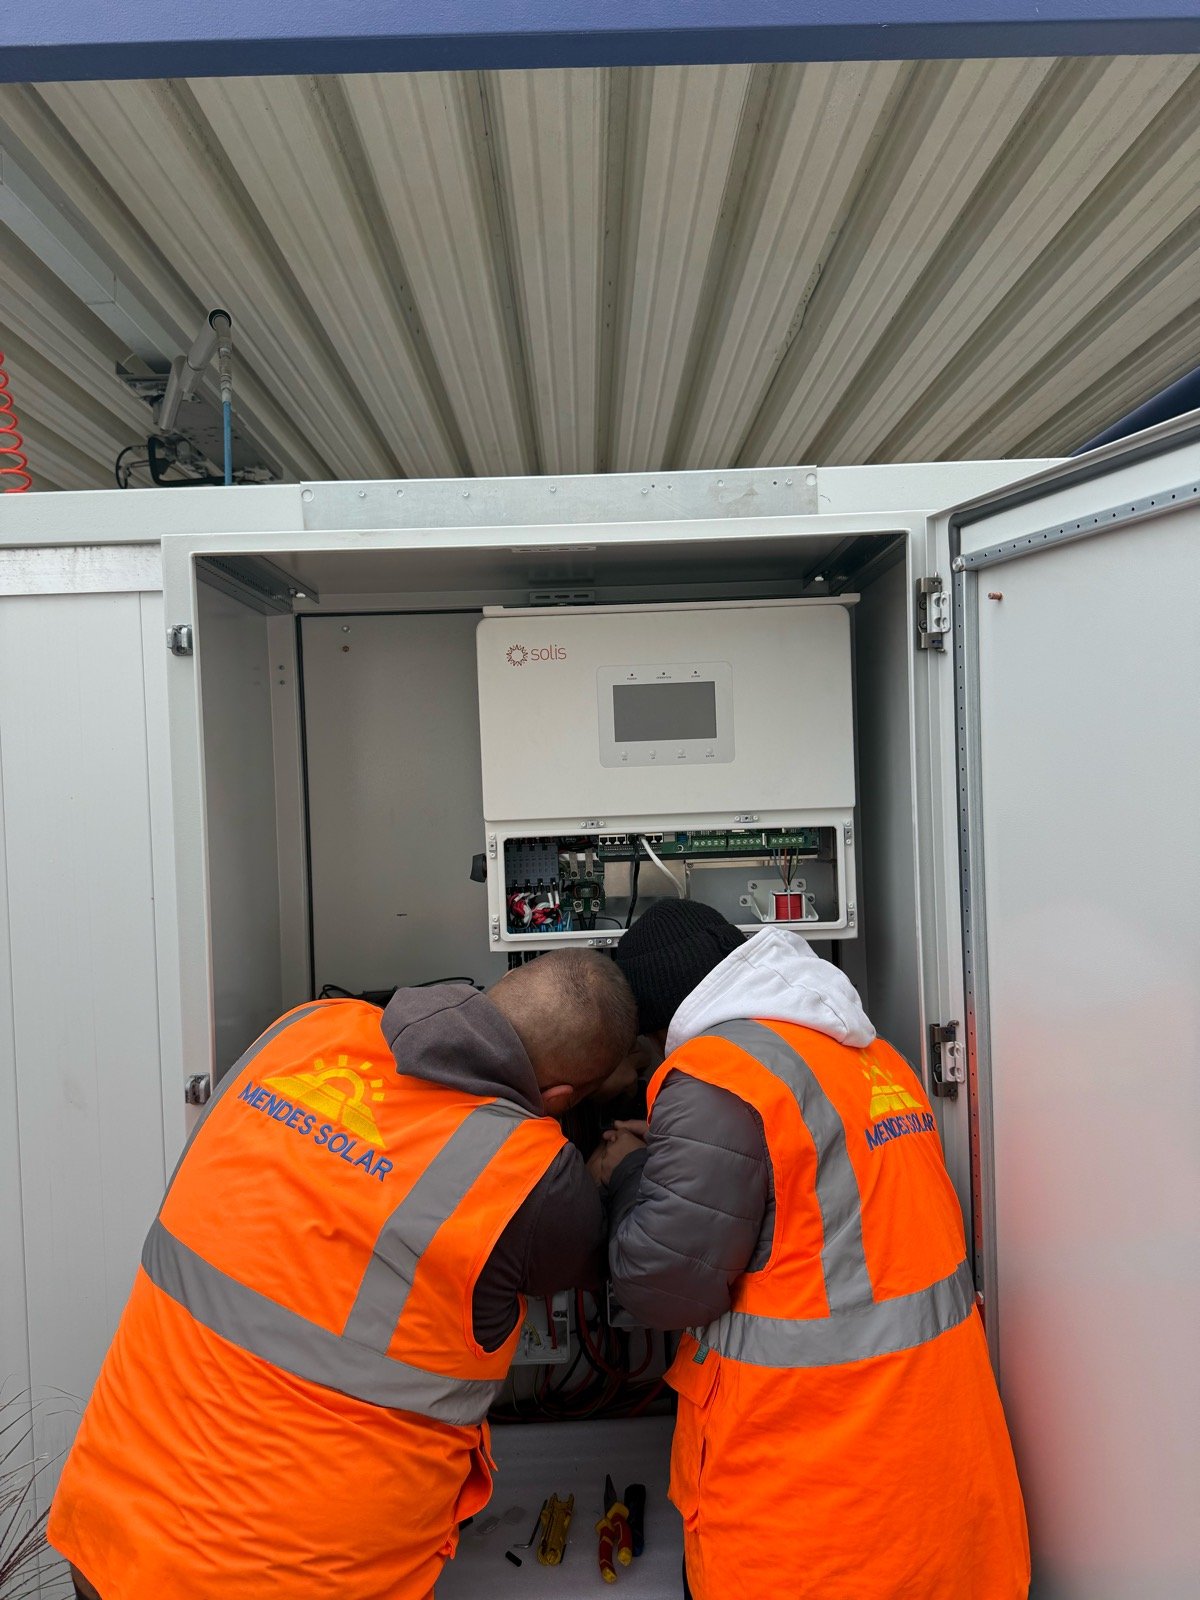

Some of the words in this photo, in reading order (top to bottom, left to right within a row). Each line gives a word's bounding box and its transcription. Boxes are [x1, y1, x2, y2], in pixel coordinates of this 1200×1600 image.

[530, 644, 567, 661] solis
[237, 1081, 317, 1135] MENDES
[313, 1124, 394, 1182] SOLAR
[864, 1115, 911, 1151] MENDES
[905, 1112, 937, 1134] SOLAR
